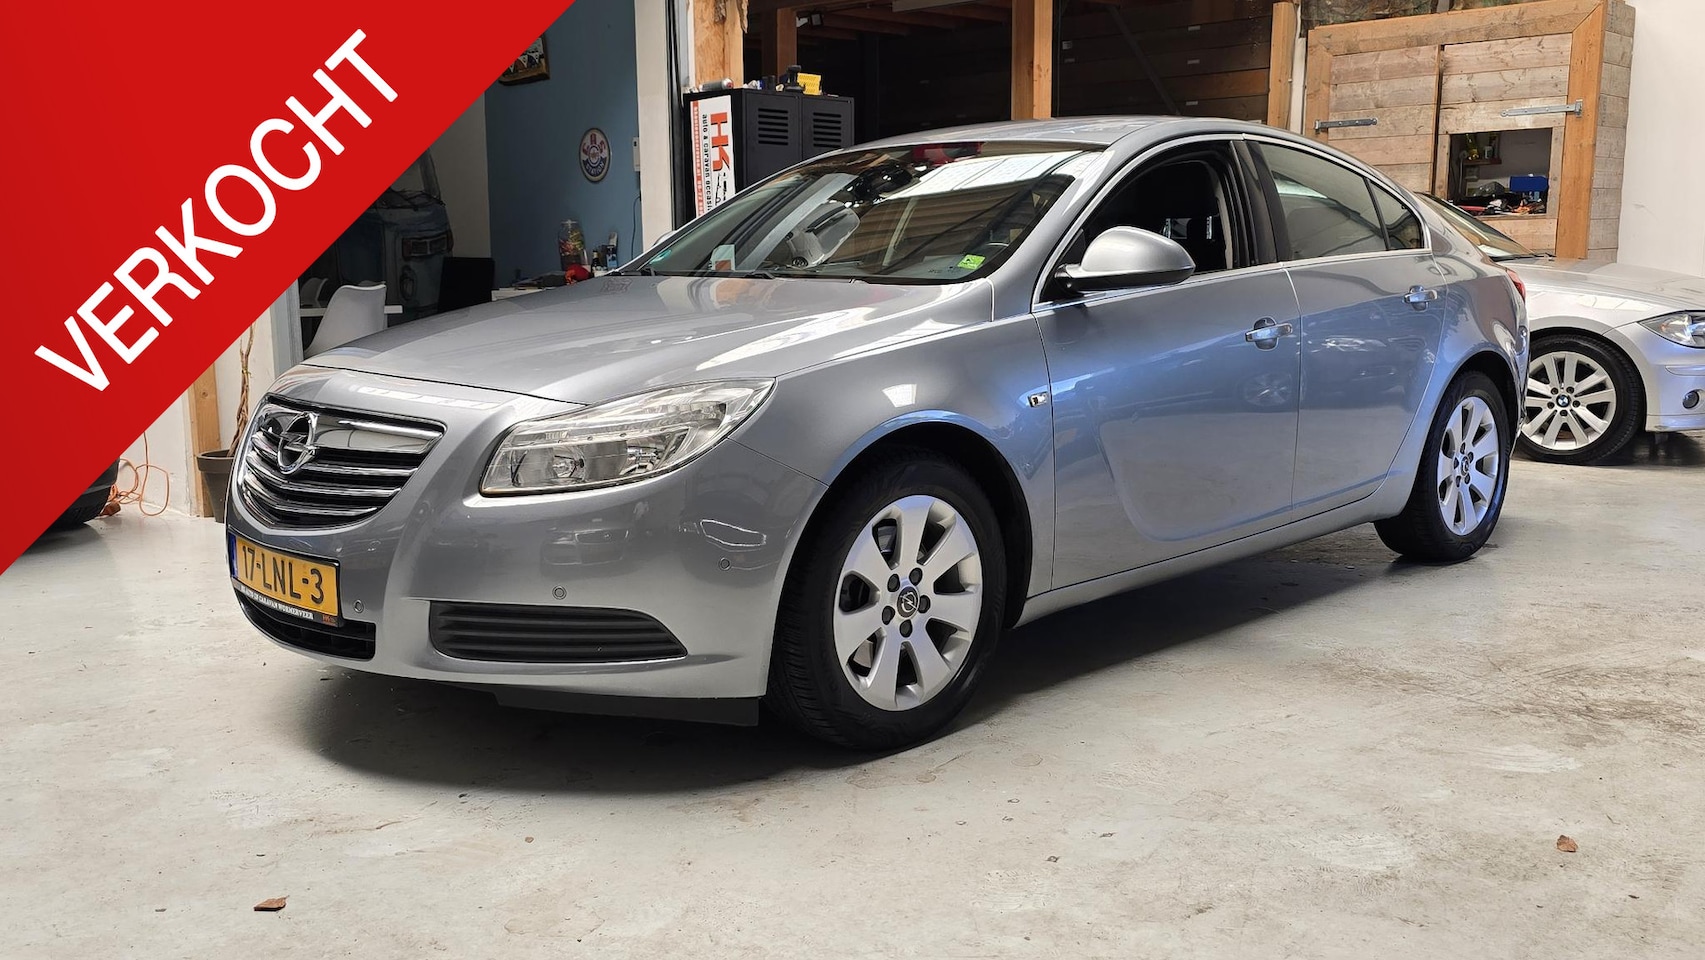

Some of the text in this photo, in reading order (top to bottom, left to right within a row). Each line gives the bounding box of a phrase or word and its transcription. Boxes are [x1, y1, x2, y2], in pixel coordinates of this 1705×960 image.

[710, 112, 730, 172] HK
[243, 545, 324, 604] 17-LNL-3
[278, 604, 314, 620] WORMERVEER
